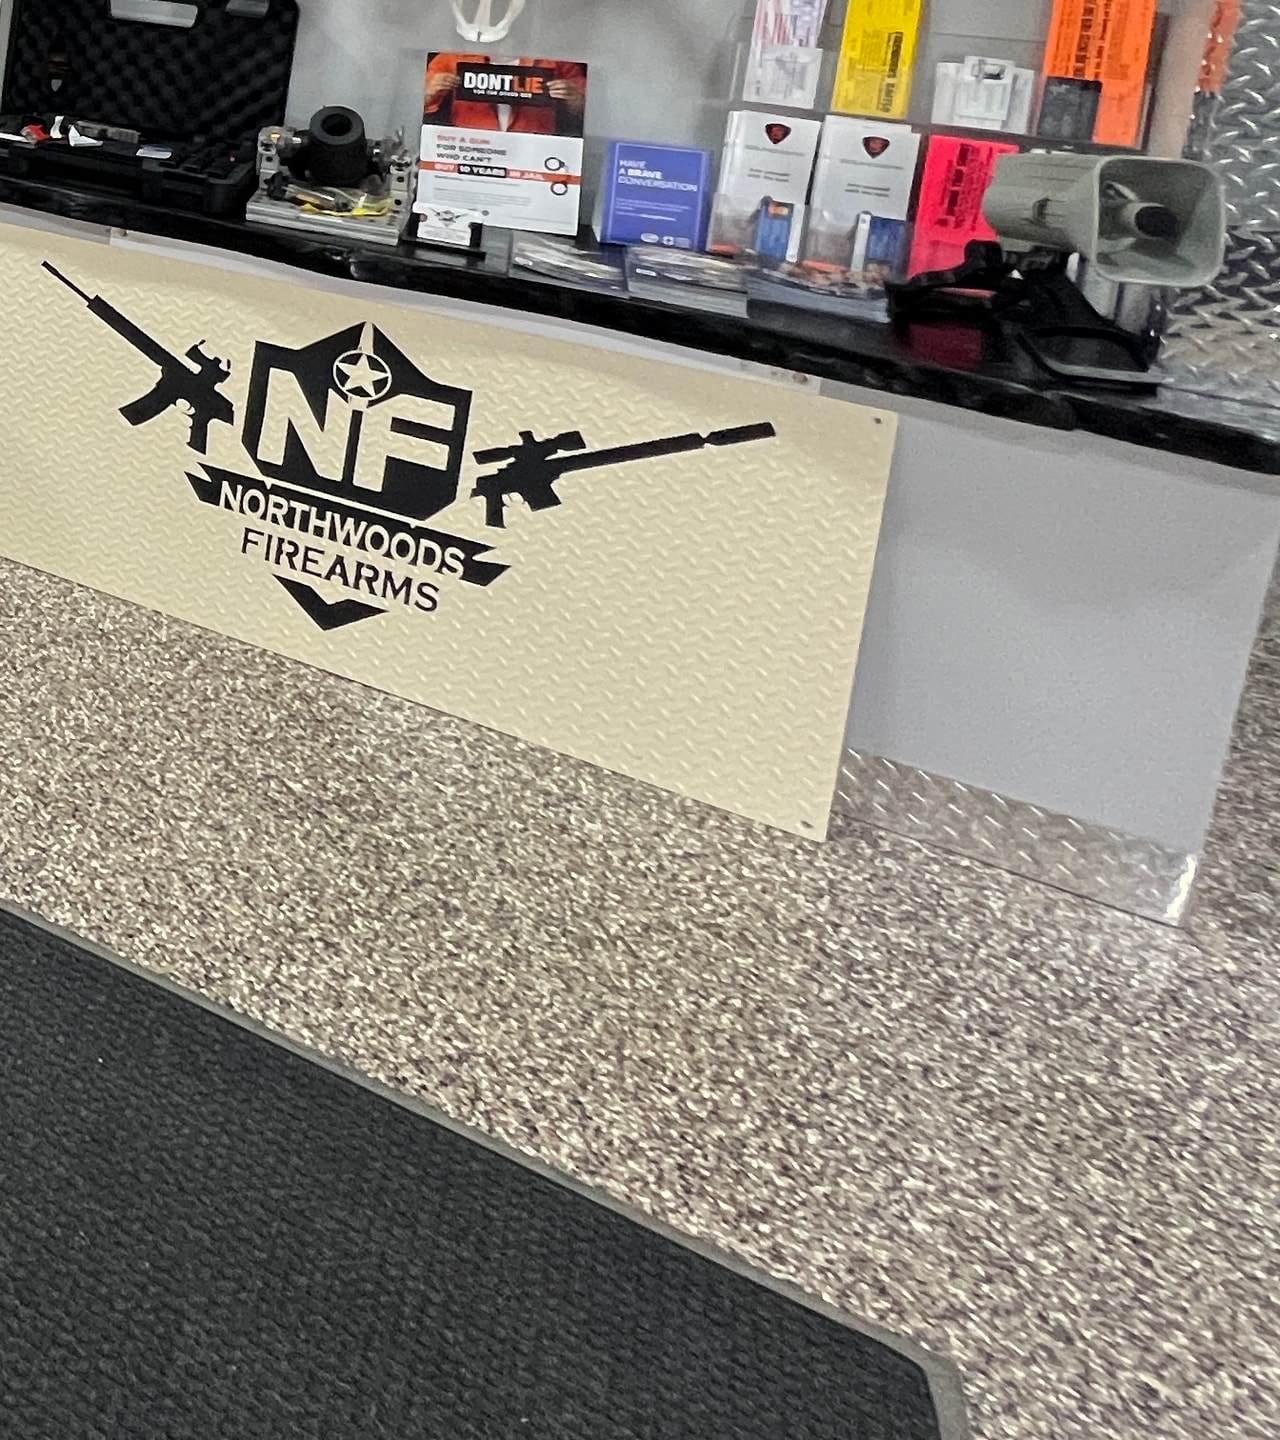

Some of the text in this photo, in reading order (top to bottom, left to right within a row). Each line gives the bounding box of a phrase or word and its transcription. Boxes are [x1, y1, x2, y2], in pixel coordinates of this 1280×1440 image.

[472, 167, 505, 177] YEARS
[618, 176, 698, 192] CONVERSATION
[628, 169, 662, 180] BRAVE
[256, 364, 456, 493] NF
[218, 478, 467, 580] NORTHWOODS
[240, 527, 440, 613] FIREARMS
